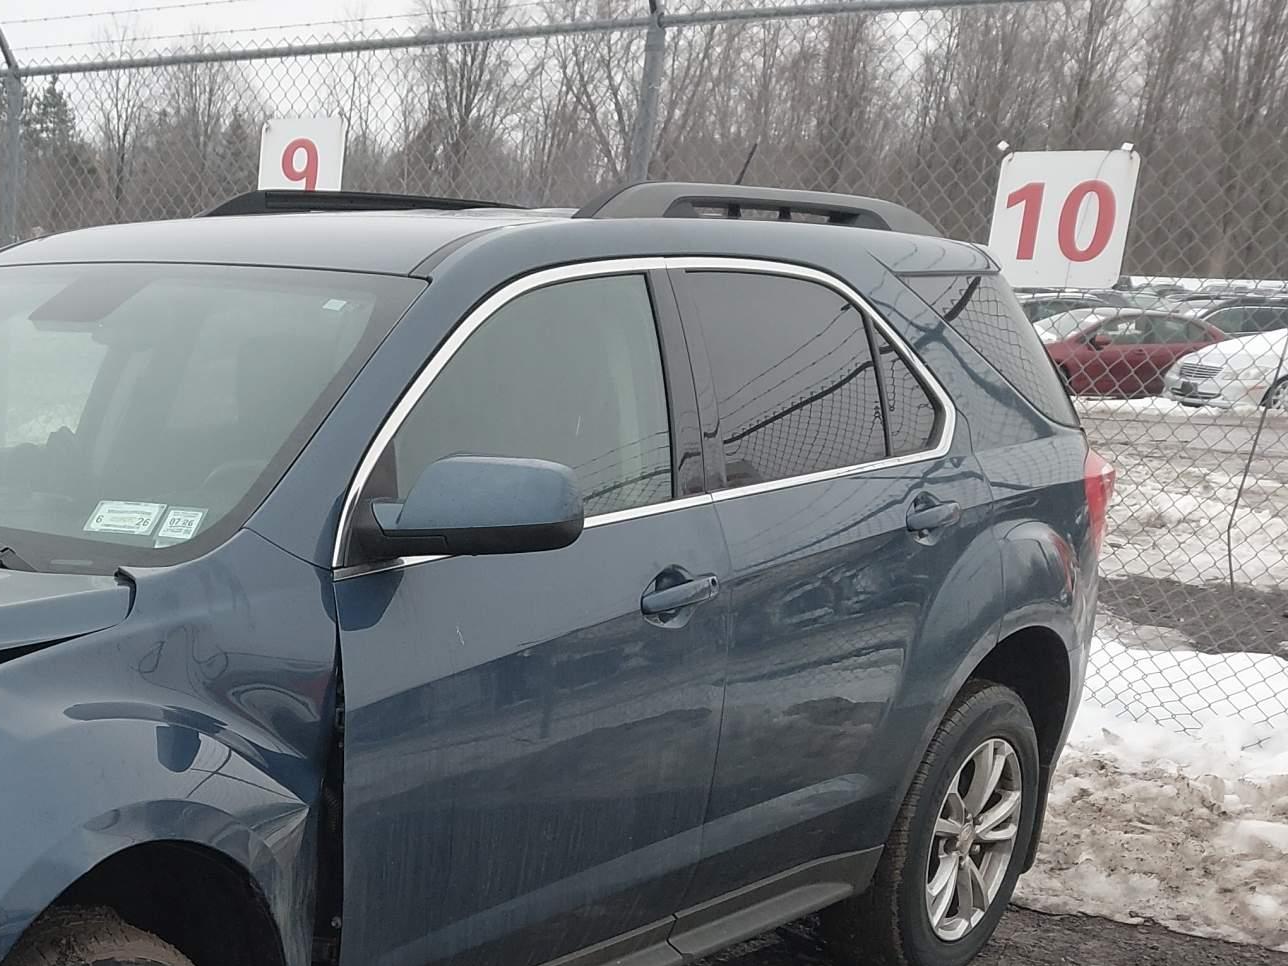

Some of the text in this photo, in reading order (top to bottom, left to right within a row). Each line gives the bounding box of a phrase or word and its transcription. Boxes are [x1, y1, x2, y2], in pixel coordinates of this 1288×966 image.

[281, 138, 319, 192] 9
[1006, 179, 1117, 262] 10
[96, 514, 104, 523] 6
[136, 518, 151, 527] 26
